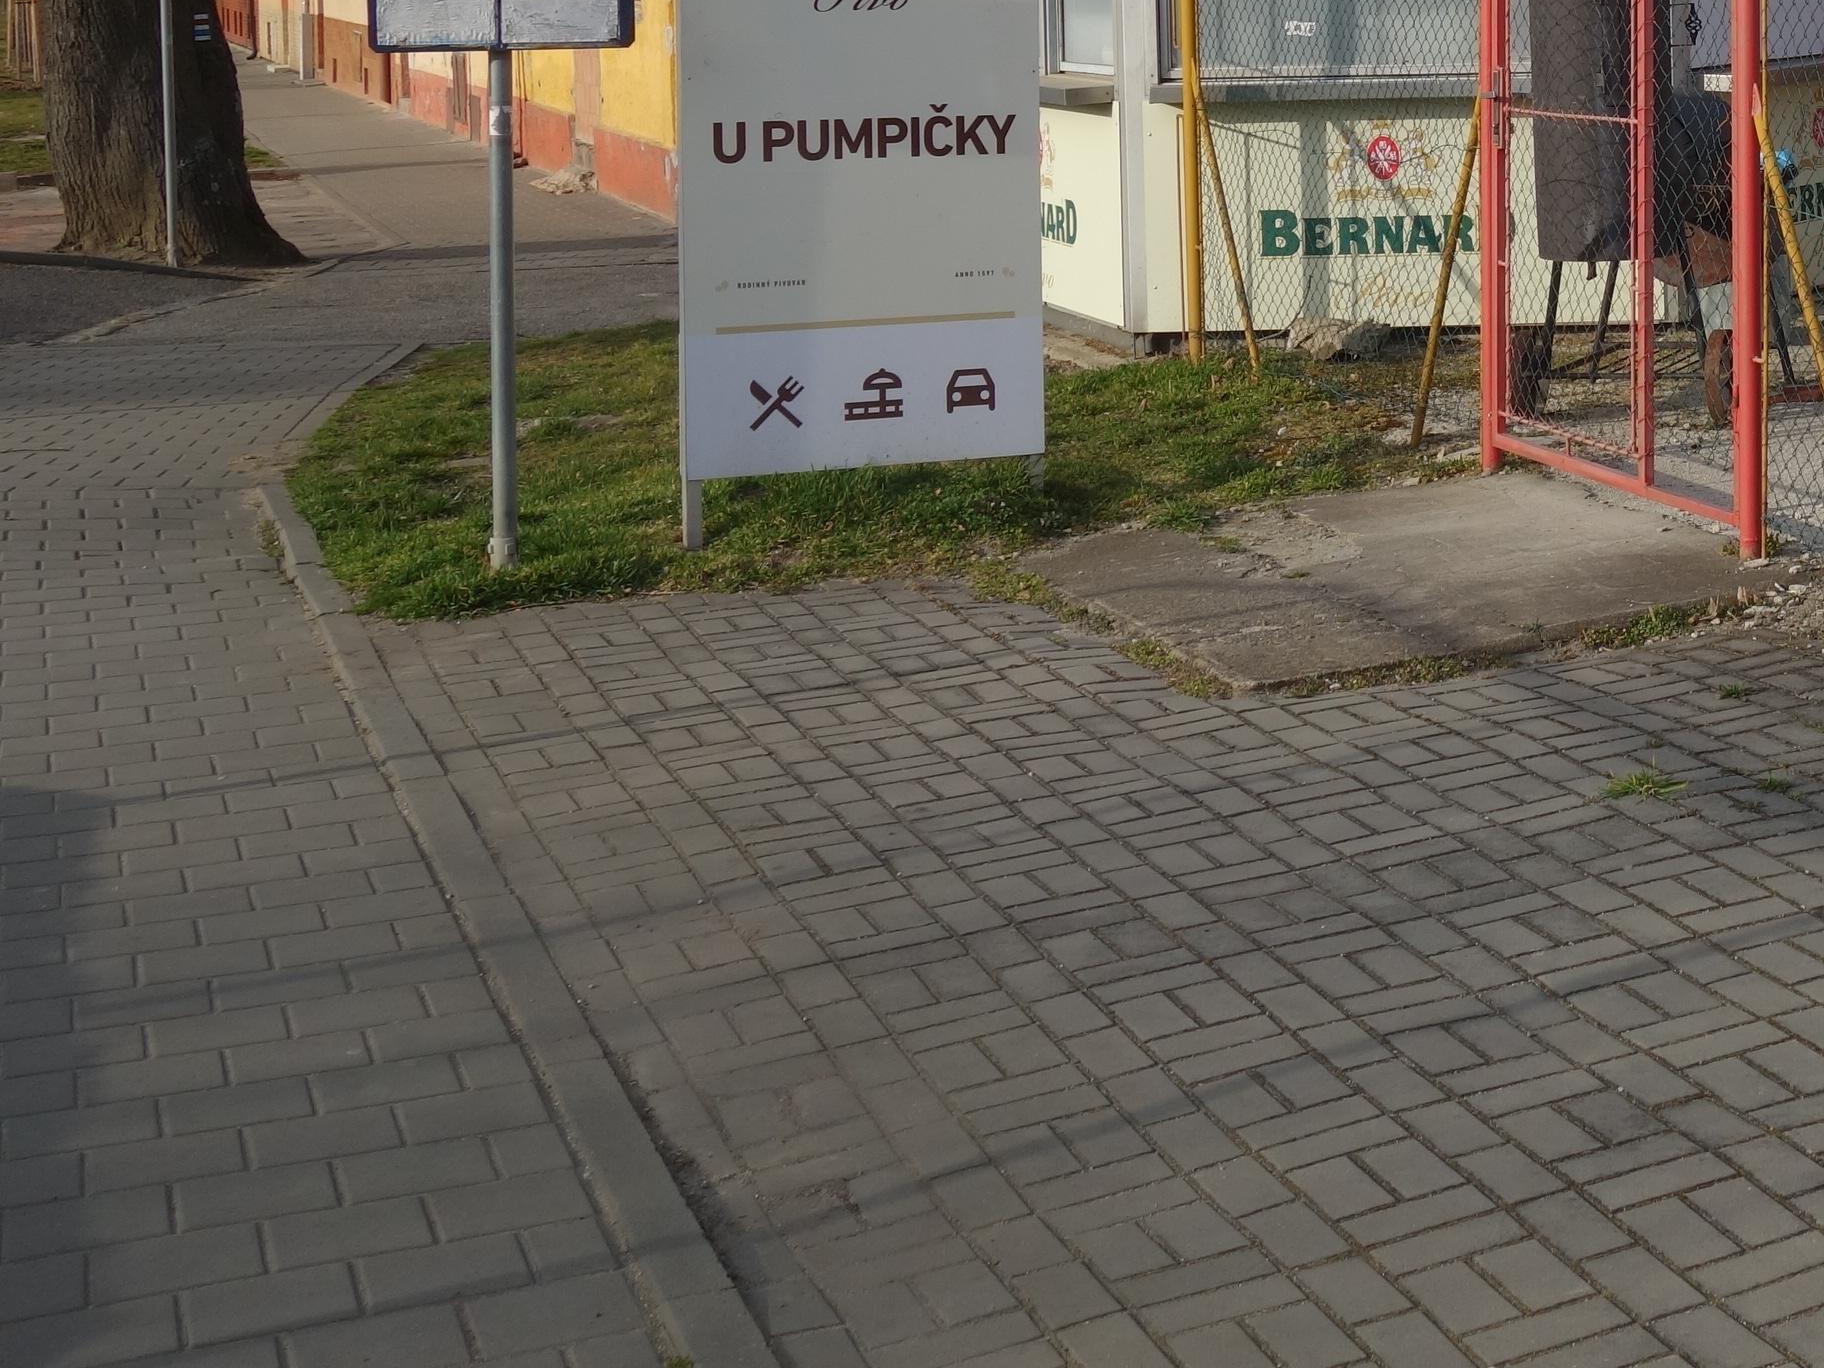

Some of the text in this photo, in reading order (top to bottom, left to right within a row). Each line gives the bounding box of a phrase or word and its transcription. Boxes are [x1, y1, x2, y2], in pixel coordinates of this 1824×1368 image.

[712, 103, 1016, 164] U PUMPIČKY
[1260, 205, 1482, 258] BERNAR
